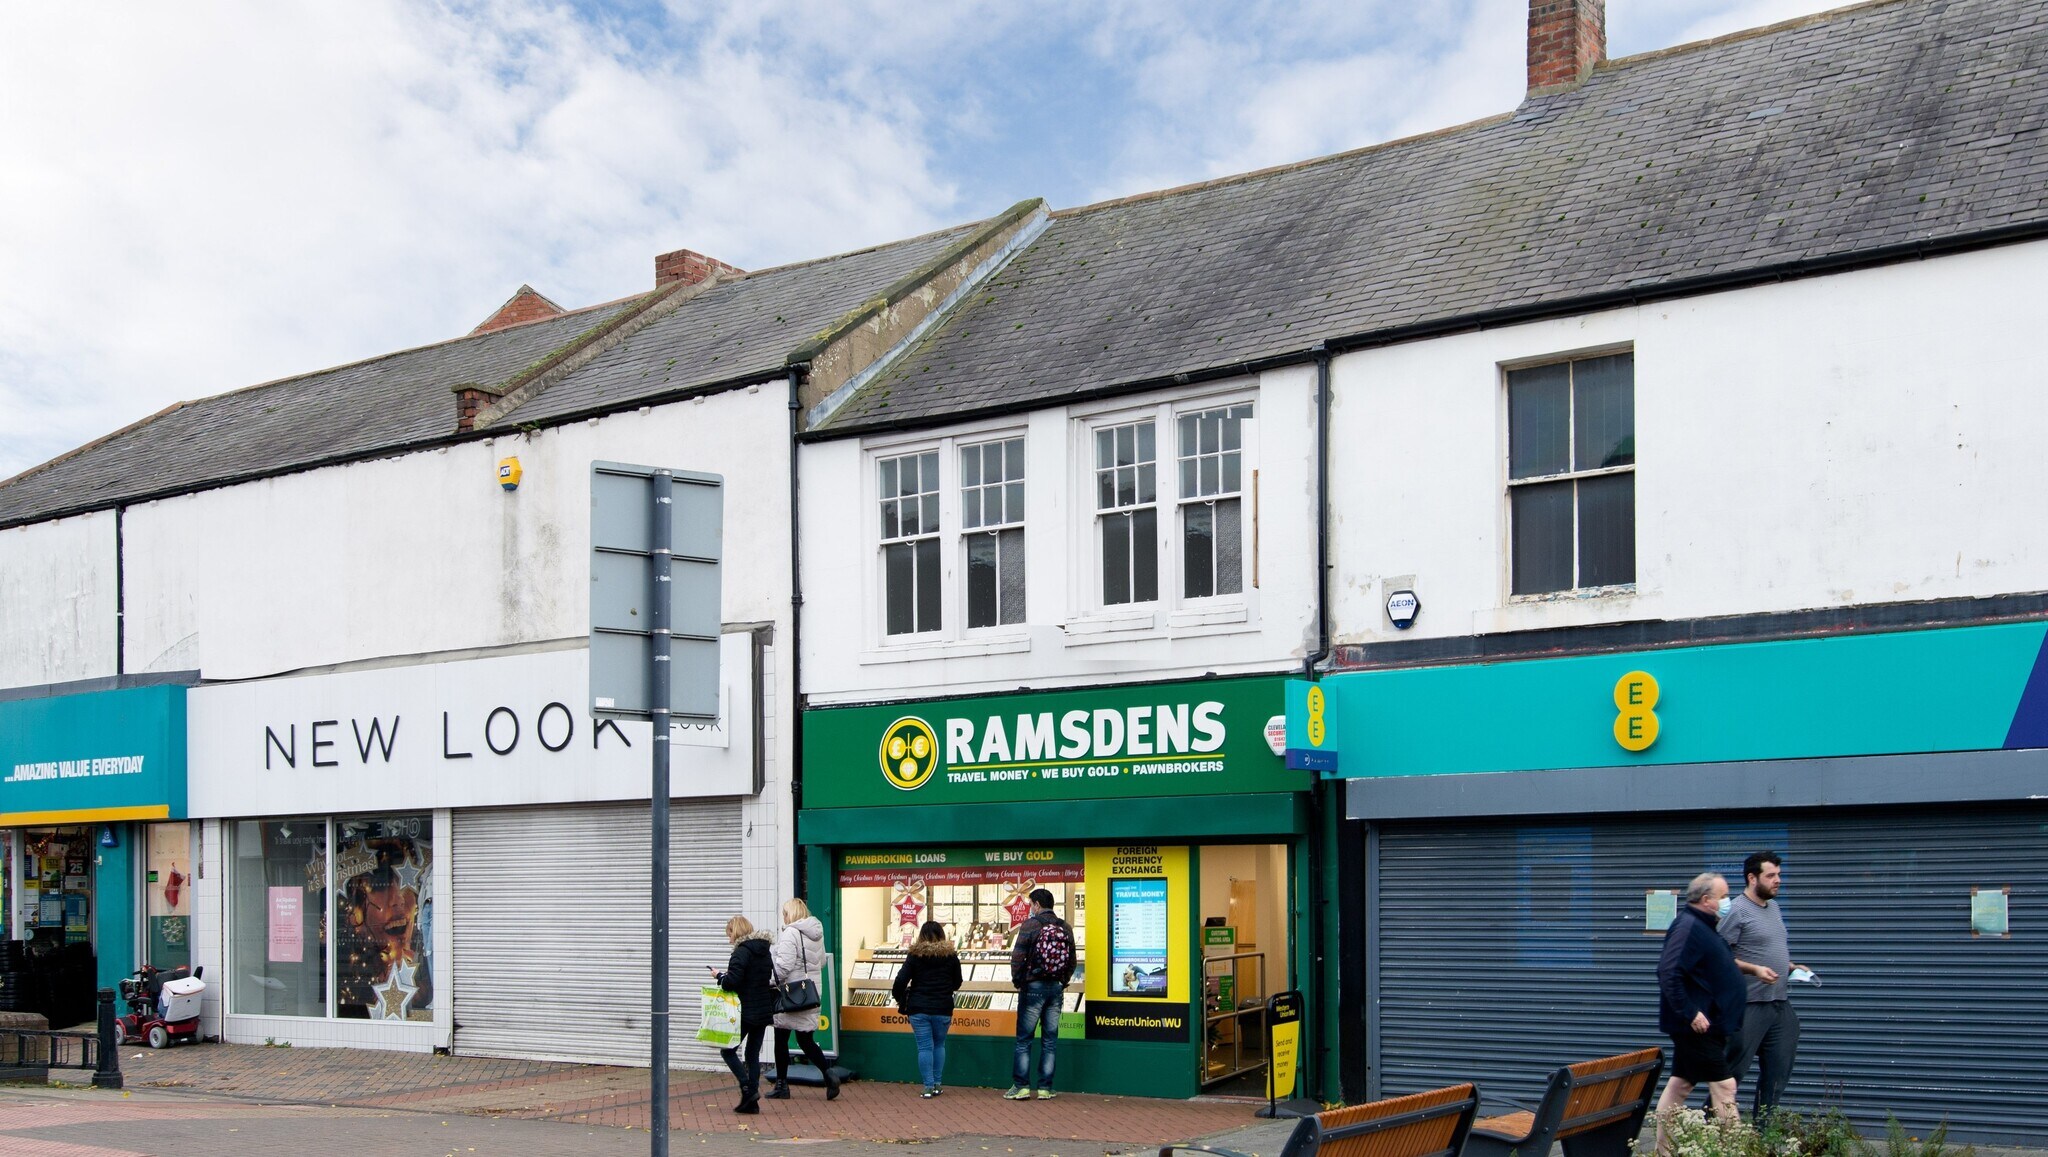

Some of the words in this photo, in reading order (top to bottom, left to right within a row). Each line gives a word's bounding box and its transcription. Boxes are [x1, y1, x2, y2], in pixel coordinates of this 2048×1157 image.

[1390, 599, 1414, 607] AEON
[265, 714, 400, 770] NEW
[444, 701, 632, 759] LOOK
[946, 701, 1226, 764] RAMSDENS
[59, 759, 90, 778] VALUE
[92, 755, 144, 776] EVERYDAY
[947, 772, 987, 783] TRAVEL
[989, 770, 1029, 781] MONEY
[1041, 768, 1059, 779] WE
[1062, 767, 1085, 778] BUY
[1087, 766, 1120, 777] GOLD
[1132, 761, 1225, 775] PAWNBROKERS
[1117, 846, 1158, 855] FOREIGN
[845, 854, 913, 864] PAWNBROKING
[915, 854, 946, 863] LOANS
[985, 852, 1000, 861] WE
[1003, 852, 1024, 861] BUY
[1026, 851, 1054, 860] GOLD
[1112, 856, 1163, 865] CURRENCY
[1112, 866, 1163, 874] EXCHANGE
[880, 1016, 910, 1024] SECON
[950, 1018, 991, 1028] ARGAINS
[1276, 1040, 1284, 1048] Send
[1276, 1061, 1288, 1069] money
